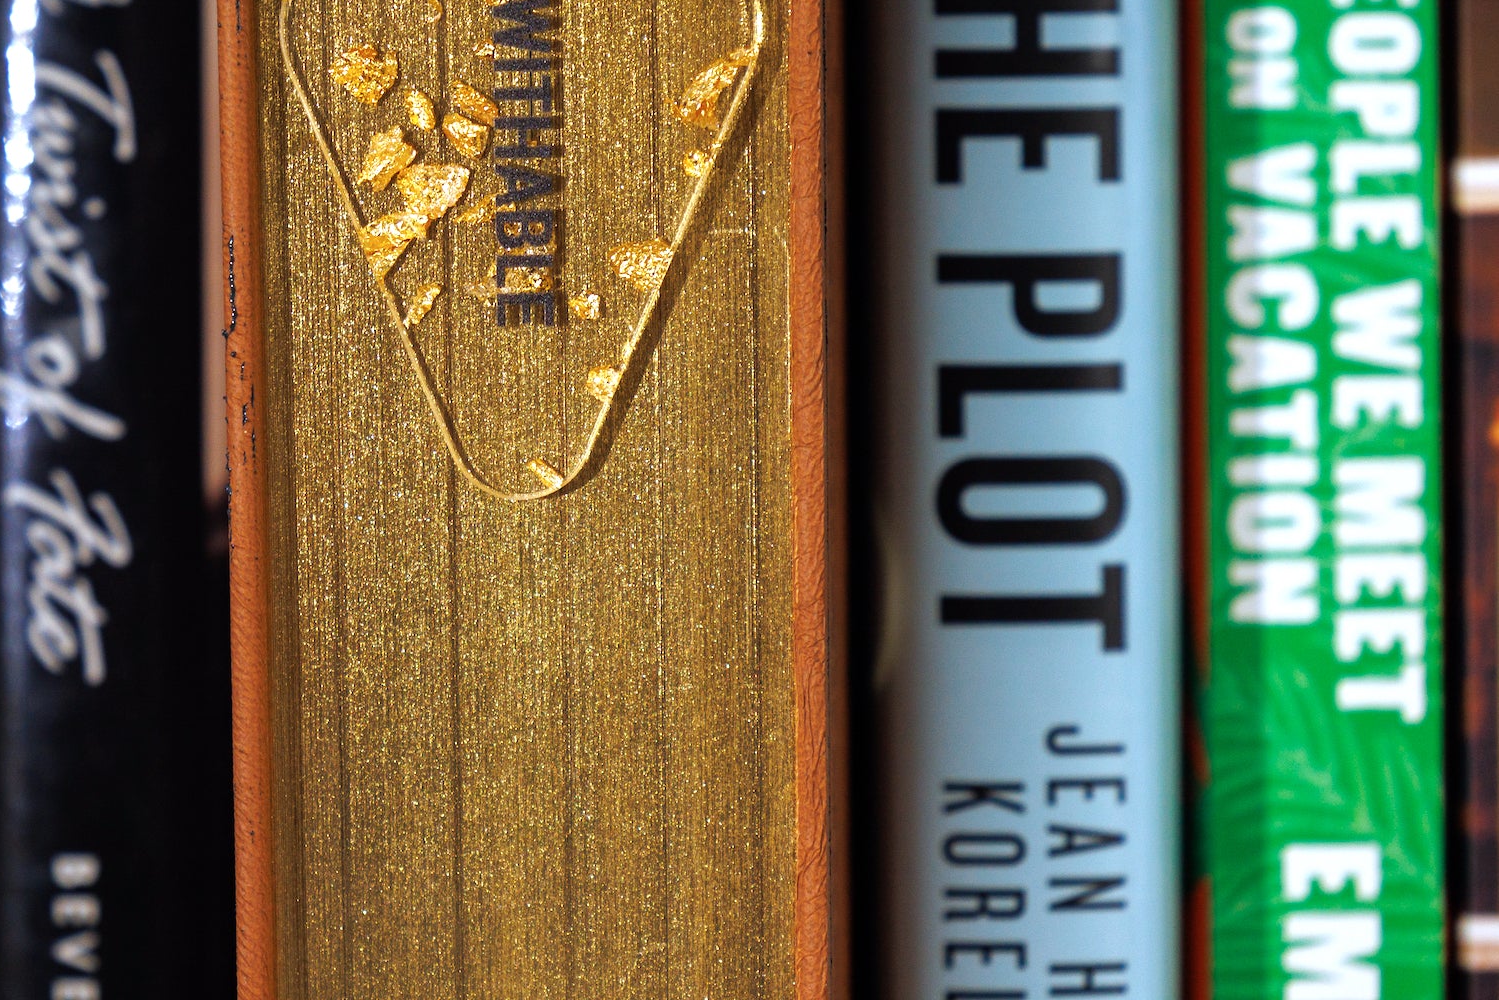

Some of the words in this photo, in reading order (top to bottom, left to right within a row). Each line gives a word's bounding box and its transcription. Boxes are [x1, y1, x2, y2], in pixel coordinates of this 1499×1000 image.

[1224, 5, 1299, 112] ON
[22, 50, 138, 359] Twist
[934, 251, 1129, 653] PLOT
[1225, 141, 1322, 626] VACATION
[1330, 278, 1424, 428] WE
[4, 467, 132, 687] Fate
[1331, 455, 1428, 726] MEET
[1045, 722, 1129, 913] JEAN
[1280, 840, 1383, 1000] EM
